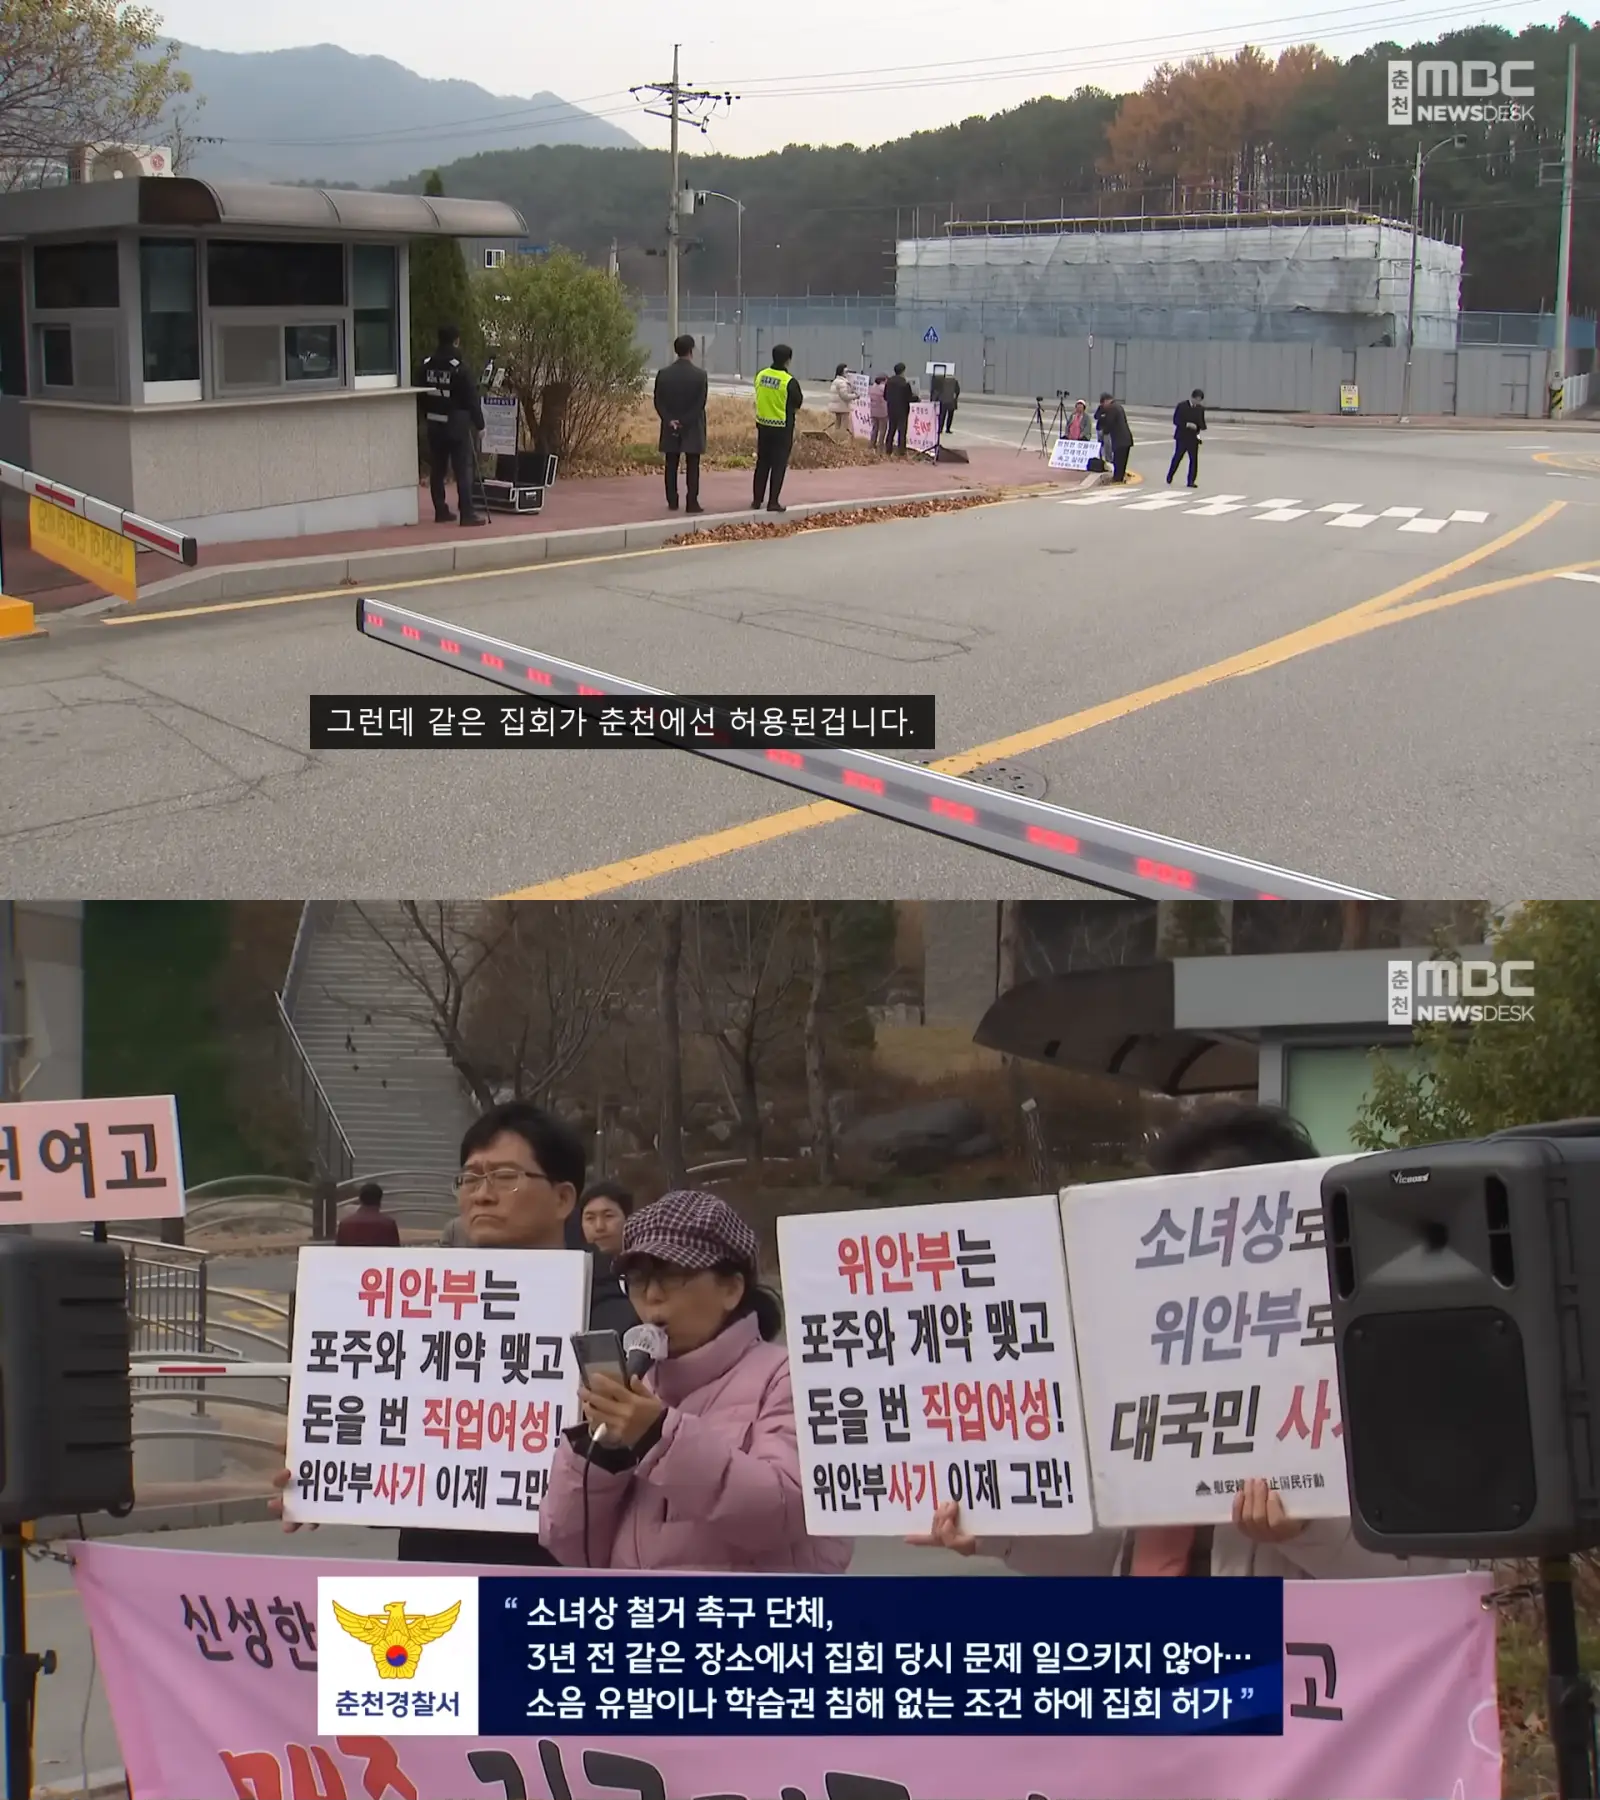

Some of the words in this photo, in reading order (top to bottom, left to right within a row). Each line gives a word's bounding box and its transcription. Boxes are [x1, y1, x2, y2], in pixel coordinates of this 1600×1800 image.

[837, 1229, 996, 1295] 위안부는
[358, 1267, 520, 1320] 위안부는
[307, 1329, 406, 1380] 포주와
[420, 1330, 486, 1383] 계약
[500, 1332, 564, 1384] 맺고
[801, 1307, 895, 1368] 포주와
[908, 1302, 973, 1364] 계약
[985, 1300, 1055, 1361] 맺고
[303, 1394, 366, 1445] 돈을
[380, 1396, 409, 1446] 번
[422, 1398, 563, 1453] 직업여성!
[808, 1387, 868, 1444] 돈을
[879, 1384, 910, 1442] 번
[921, 1378, 1065, 1442] 직업여성!
[1110, 1384, 1260, 1462] 대국민
[1275, 1379, 1344, 1450] 사
[297, 1460, 425, 1506] 위안부사기
[436, 1465, 488, 1510] 이제
[813, 1460, 938, 1511] 위안부사기
[948, 1459, 1001, 1510] 이제
[1010, 1458, 1074, 1508] 그만!
[180, 1594, 317, 1672] 신성한
